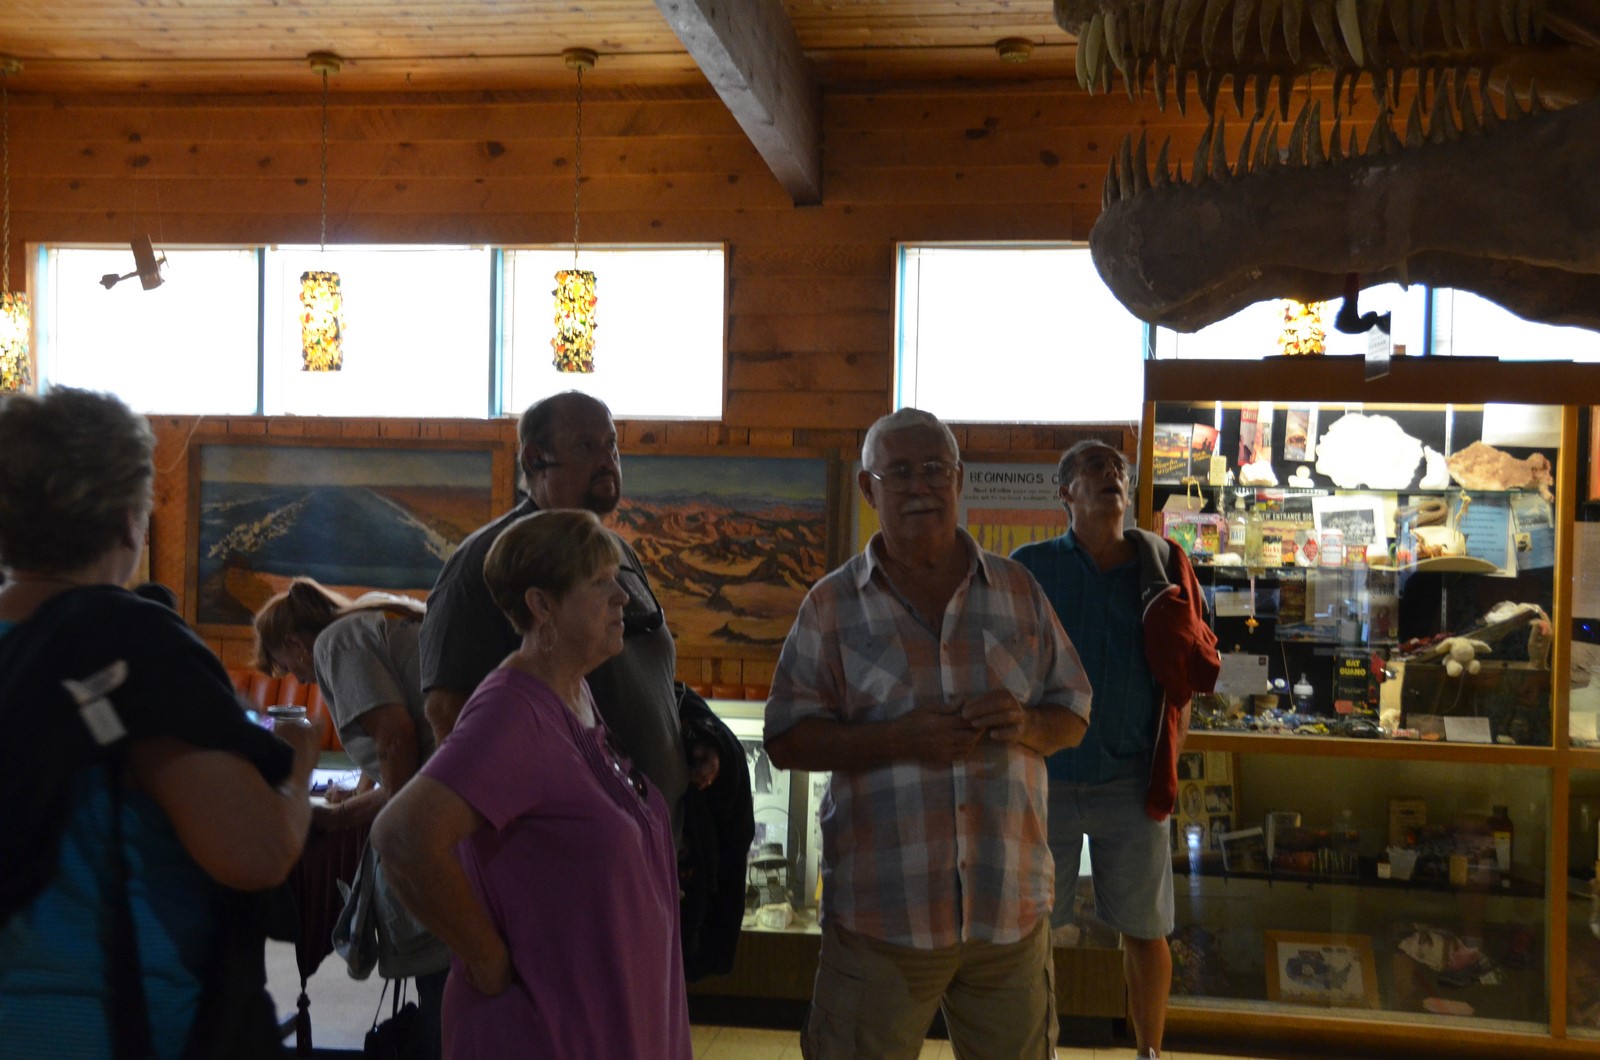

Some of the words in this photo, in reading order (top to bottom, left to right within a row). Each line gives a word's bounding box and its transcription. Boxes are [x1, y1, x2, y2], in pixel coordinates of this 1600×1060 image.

[969, 472, 1044, 484] BEGINNINGS
[1272, 512, 1301, 521] ENTRANCE
[1339, 667, 1366, 677] GUANO
